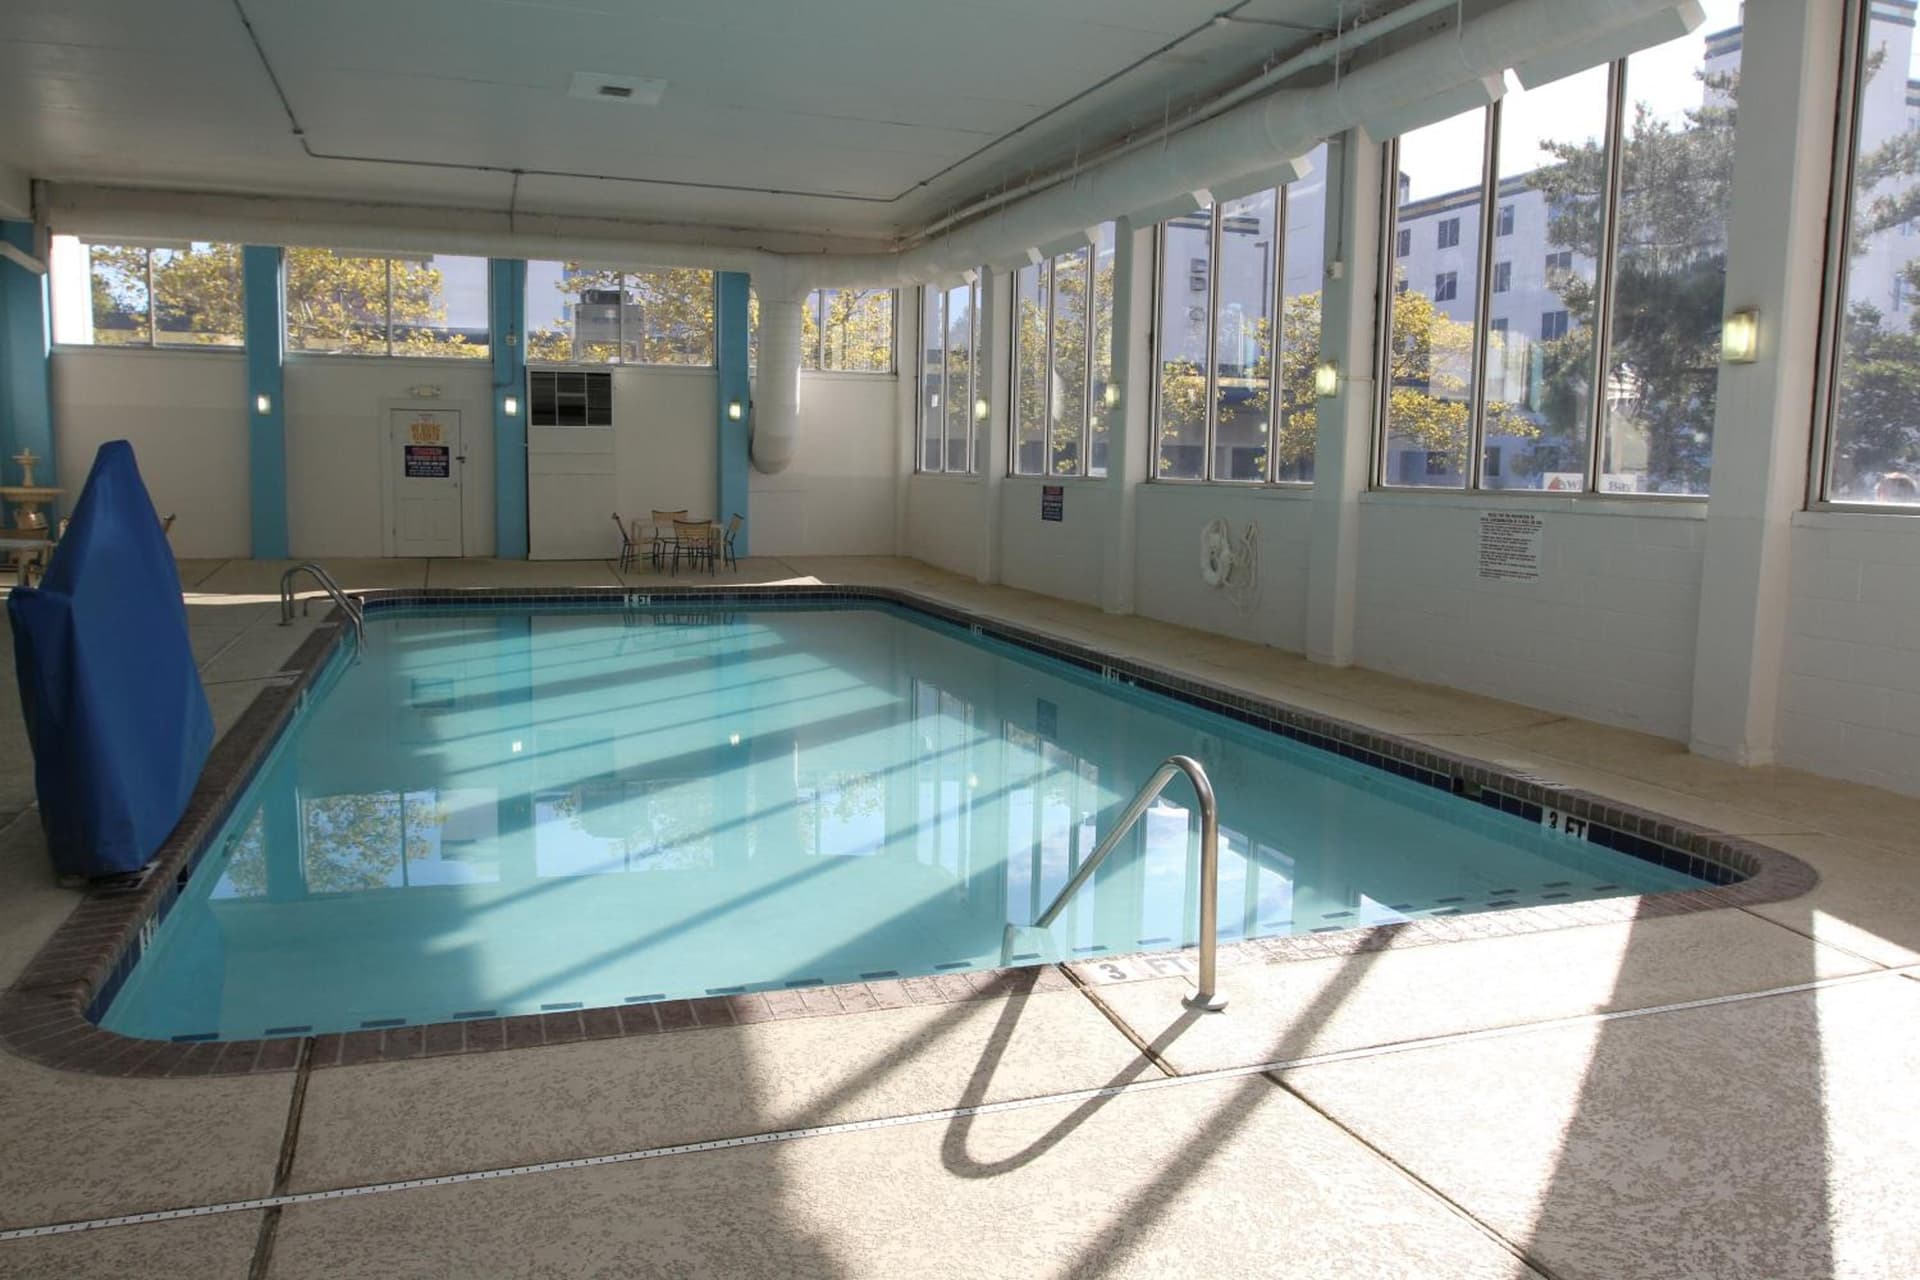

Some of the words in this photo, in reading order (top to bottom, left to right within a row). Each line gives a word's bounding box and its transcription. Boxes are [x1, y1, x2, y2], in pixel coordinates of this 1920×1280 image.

[1565, 815, 1587, 838] FT
[1099, 963, 1127, 980] 3
[1144, 956, 1191, 975] FT
